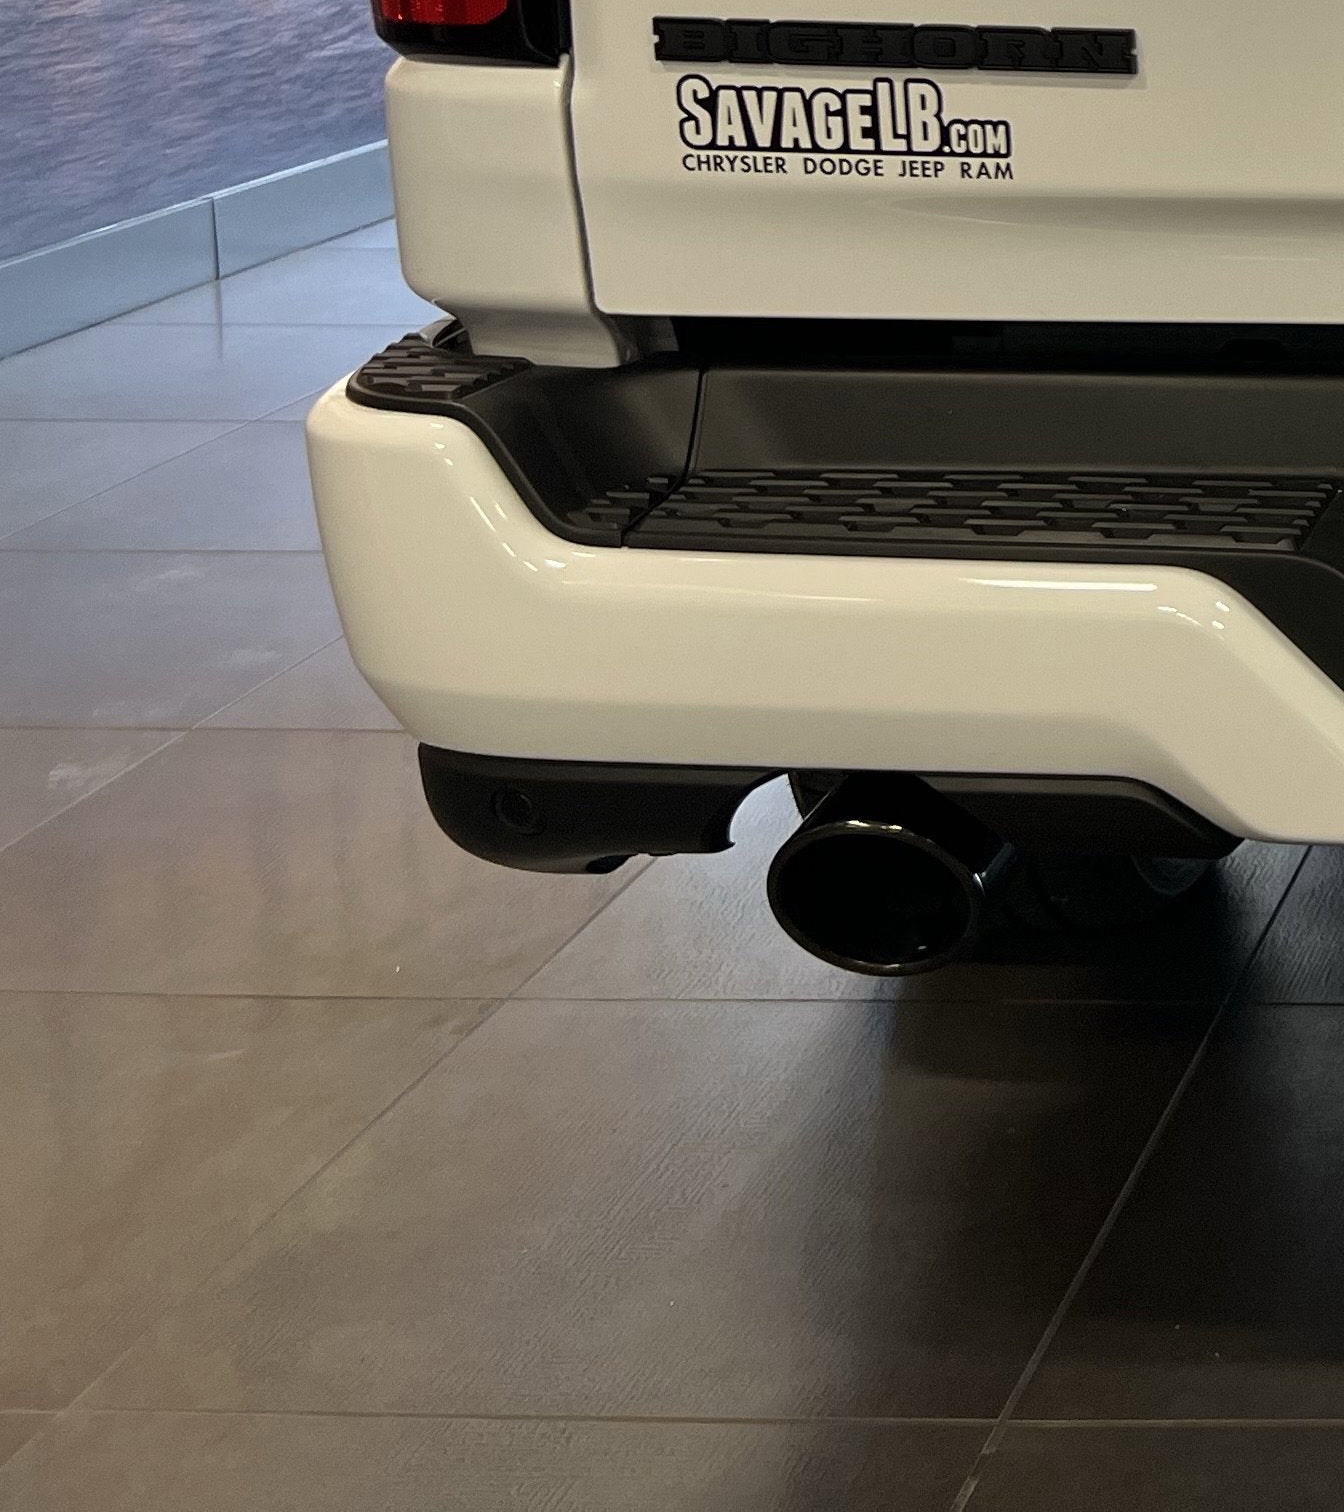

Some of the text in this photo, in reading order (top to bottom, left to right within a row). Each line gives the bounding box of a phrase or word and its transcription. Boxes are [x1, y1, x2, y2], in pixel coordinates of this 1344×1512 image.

[653, 16, 1138, 74] BIGHORN
[682, 153, 1014, 180] CHRYSLER DODGE JEEP RAM
